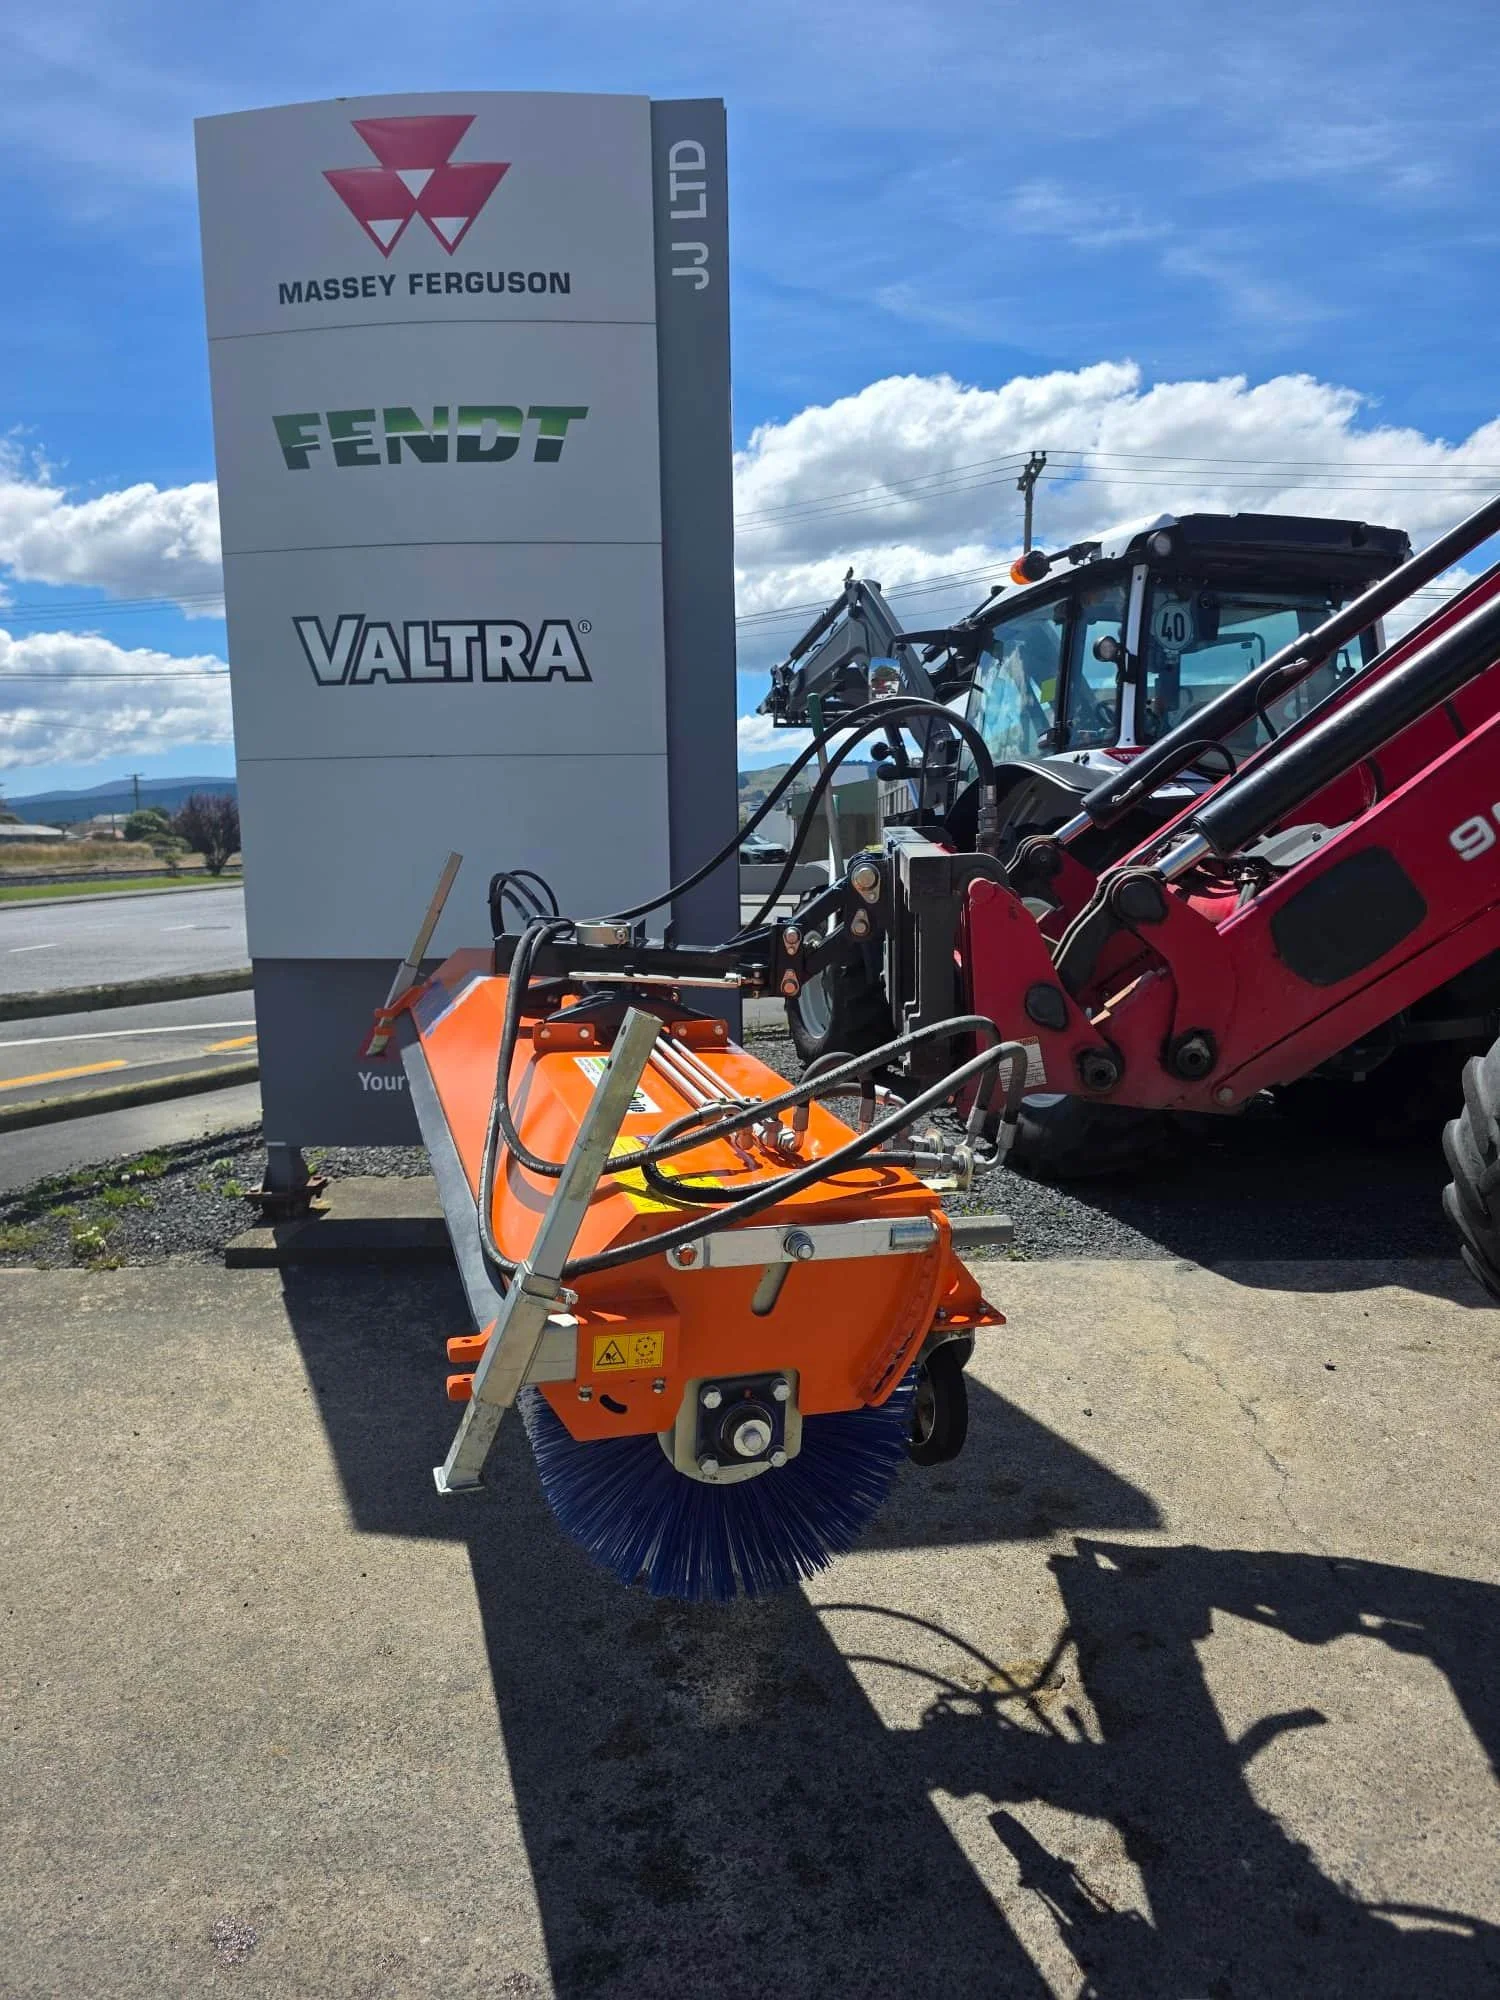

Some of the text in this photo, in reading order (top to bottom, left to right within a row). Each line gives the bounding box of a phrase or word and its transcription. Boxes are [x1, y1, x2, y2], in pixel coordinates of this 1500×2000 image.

[669, 139, 710, 290] JJ LTD
[278, 271, 571, 305] MASSEY FERGUSON
[272, 406, 589, 470] FENDT
[1161, 612, 1185, 641] 40
[358, 1071, 405, 1091] Your
